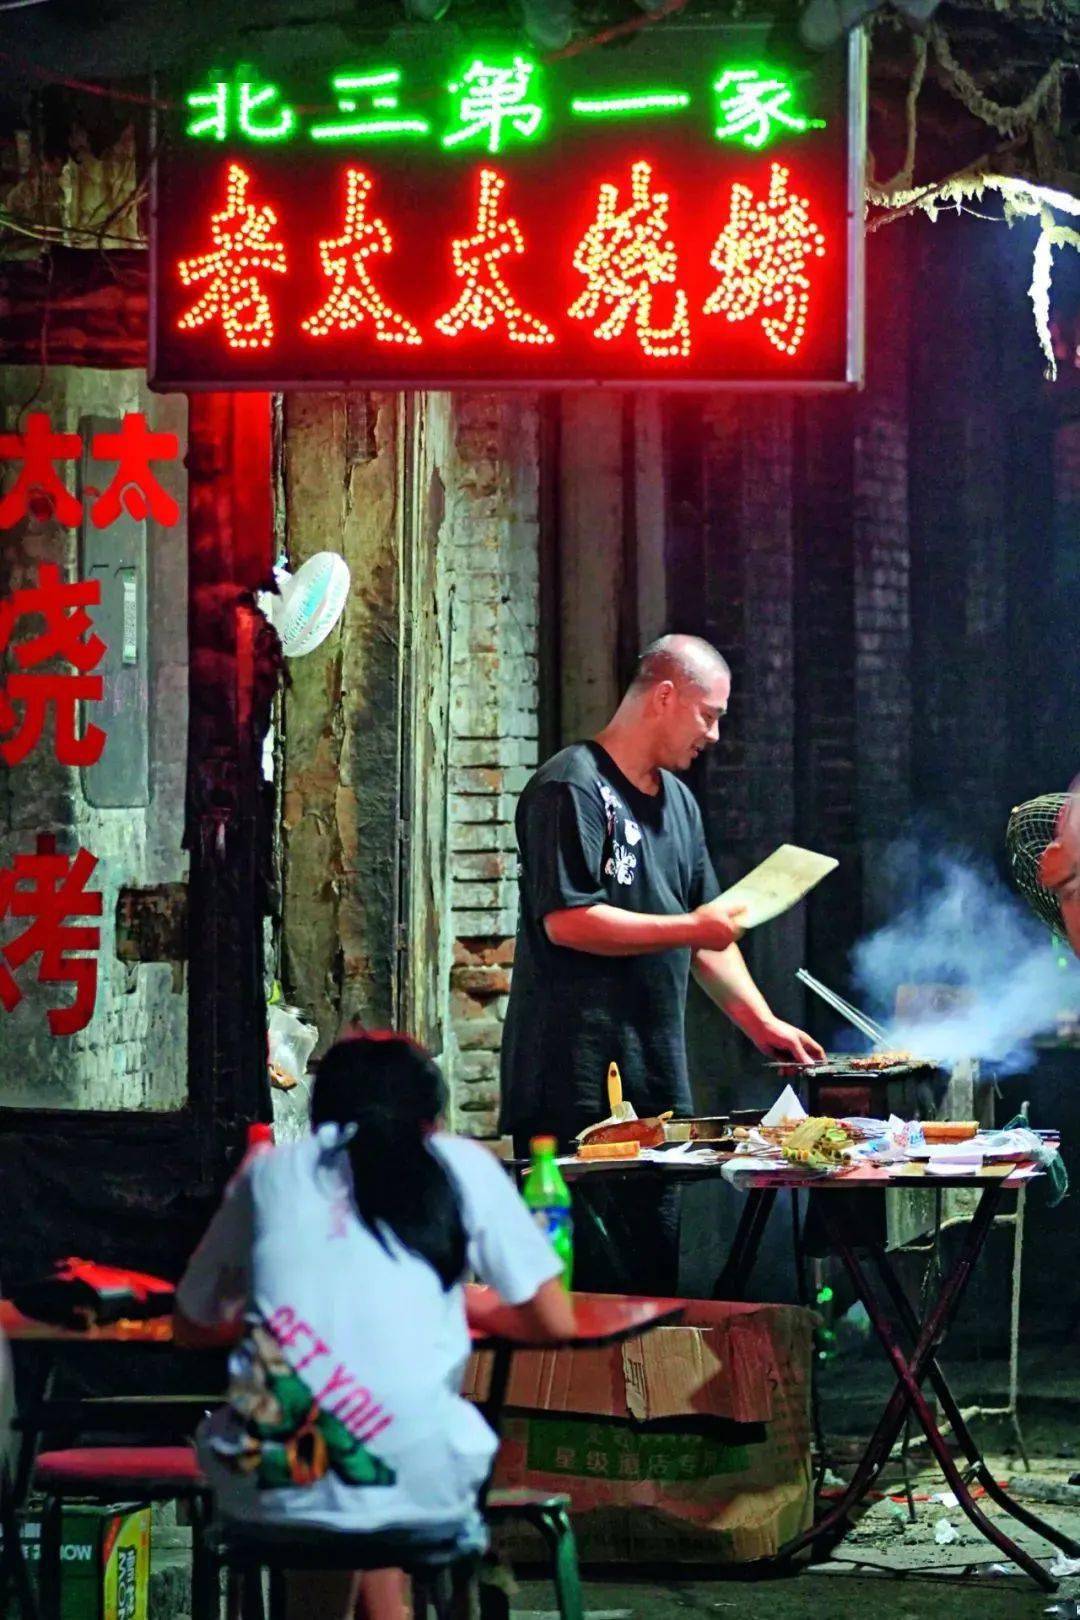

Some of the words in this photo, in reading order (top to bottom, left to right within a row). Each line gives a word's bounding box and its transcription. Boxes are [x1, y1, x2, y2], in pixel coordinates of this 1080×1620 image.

[185, 57, 826, 153] 北三第一家
[178, 160, 825, 356] 老太太烧烤
